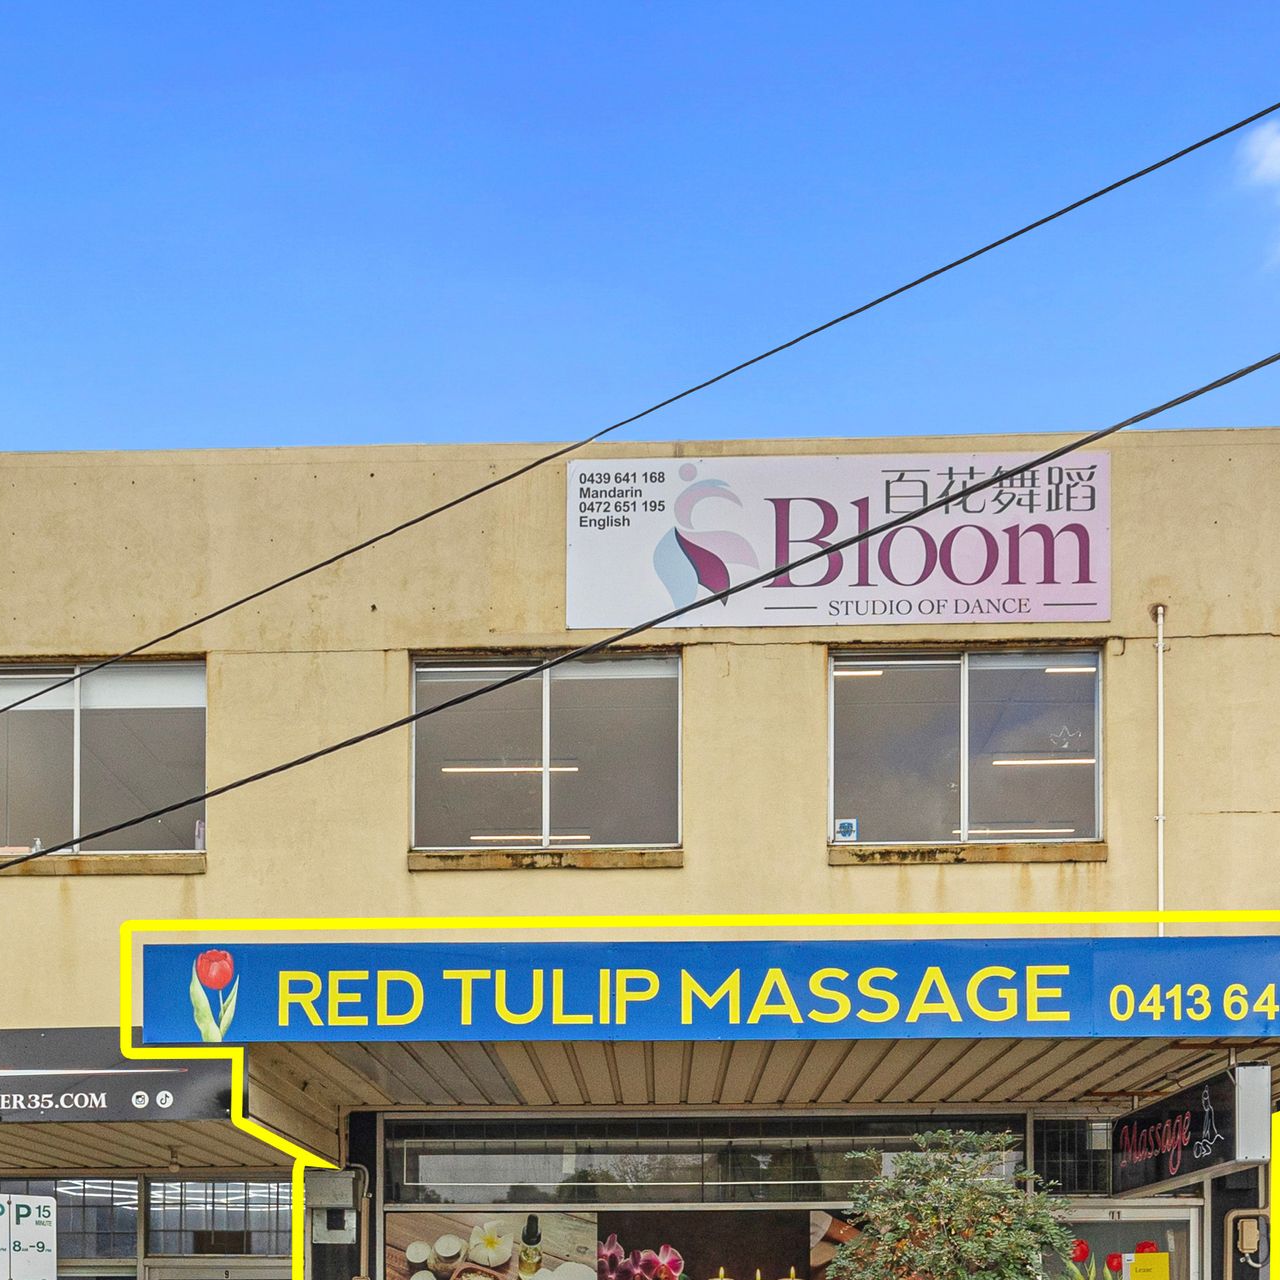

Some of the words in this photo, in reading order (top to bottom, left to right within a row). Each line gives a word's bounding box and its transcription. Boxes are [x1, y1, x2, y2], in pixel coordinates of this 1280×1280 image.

[579, 472, 611, 484] 0439
[614, 472, 637, 484] 641
[642, 471, 665, 483] 168
[579, 486, 642, 498] Mandarin
[881, 465, 1098, 514] 百花舞蹈
[579, 501, 611, 513] 0472
[614, 501, 637, 512] 651
[642, 500, 665, 512] 195
[579, 515, 630, 530] English
[762, 496, 1098, 588] Bloom
[828, 599, 912, 616] STUDIO
[918, 599, 948, 616] OF
[954, 598, 1031, 615] DANCE
[278, 970, 424, 1026] RED
[443, 968, 660, 1026] TULIP
[682, 964, 1070, 1025] MASSAGE
[1110, 982, 1212, 1021] 0413
[1120, 1111, 1192, 1175] Massage
[15, 1203, 32, 1225] P
[35, 1205, 51, 1218] 15
